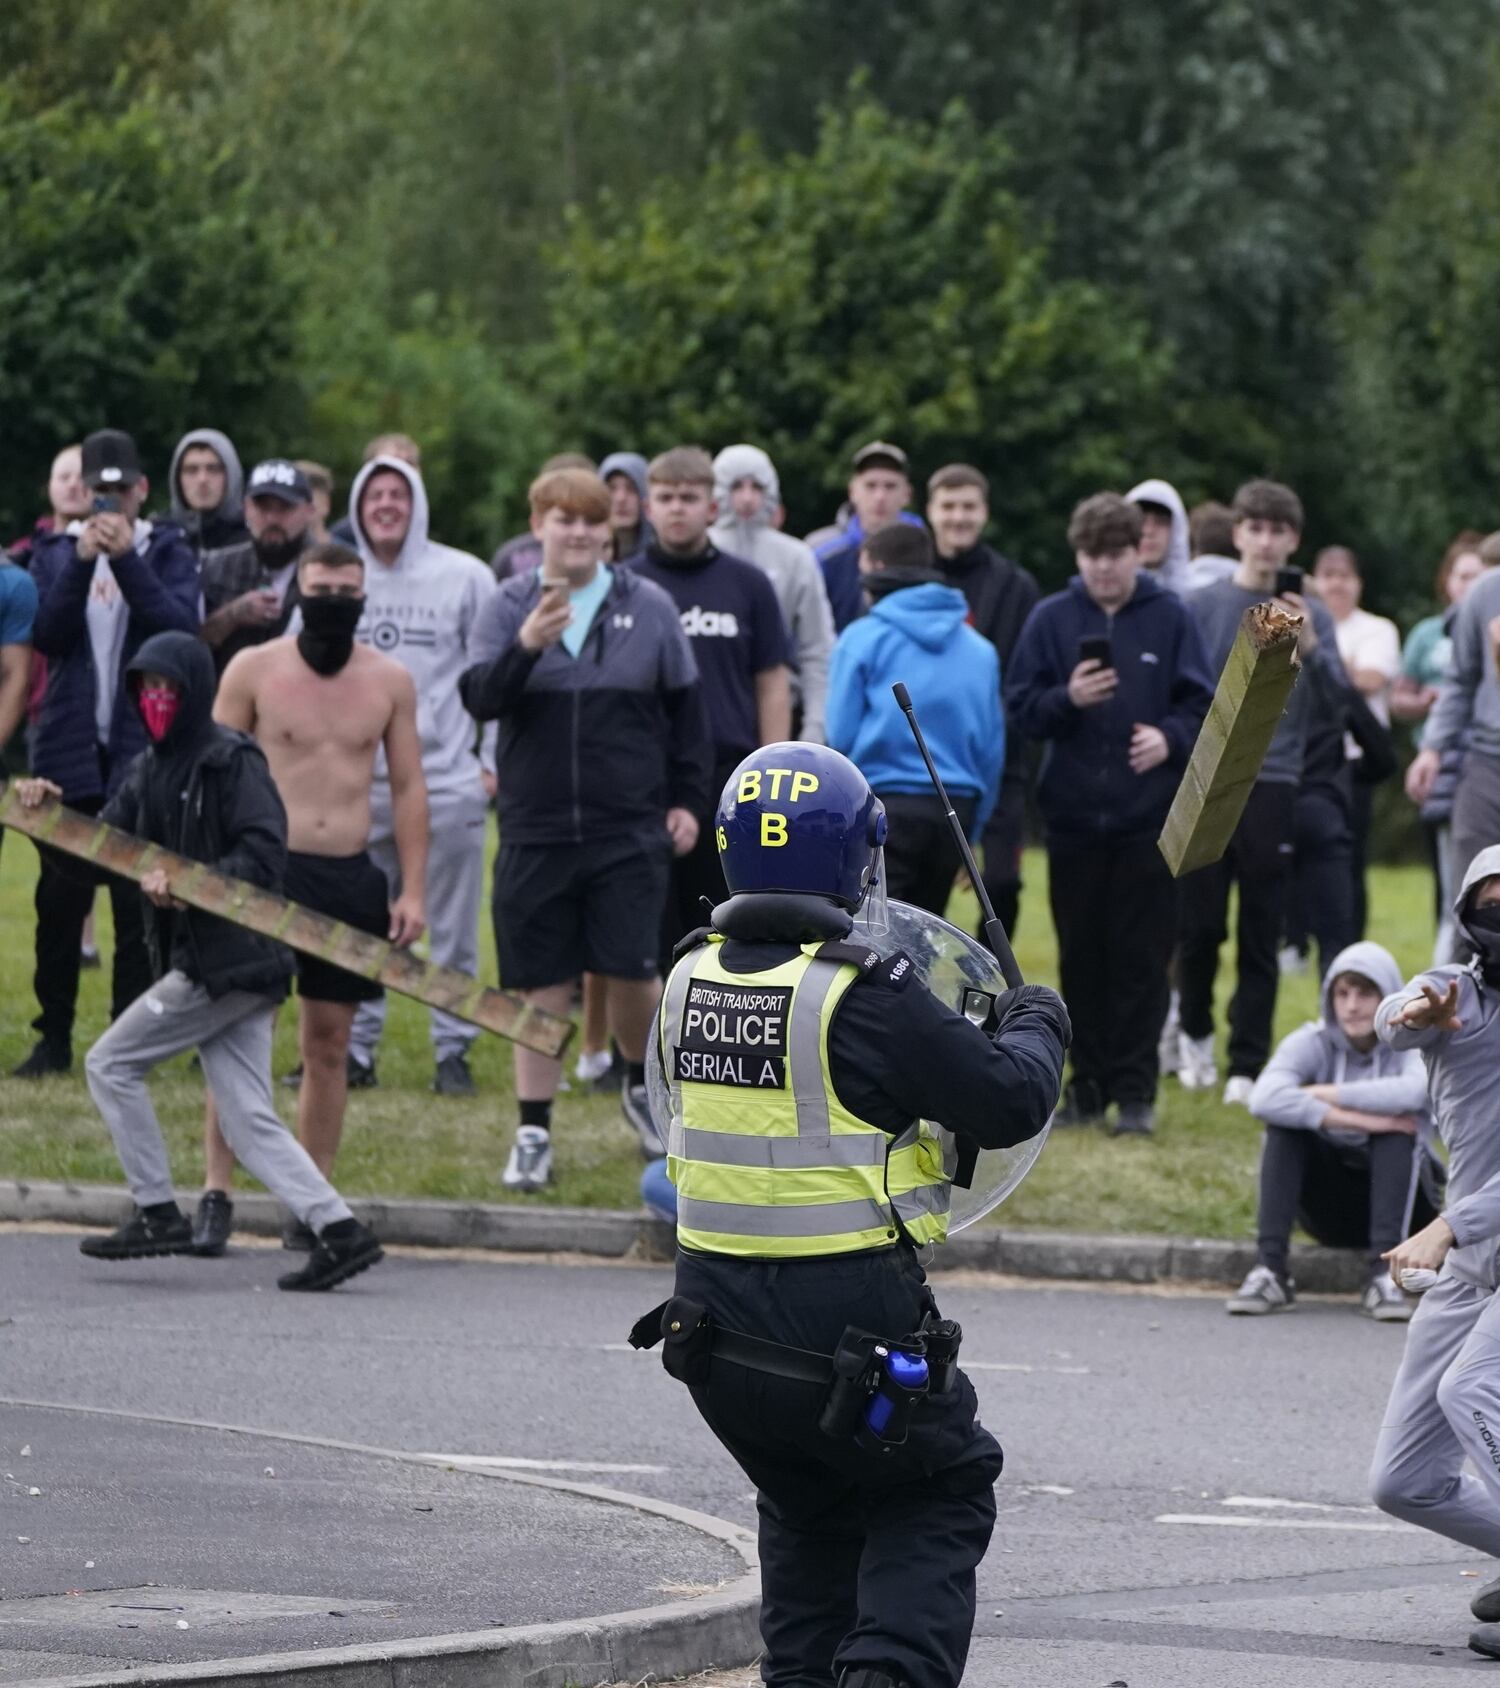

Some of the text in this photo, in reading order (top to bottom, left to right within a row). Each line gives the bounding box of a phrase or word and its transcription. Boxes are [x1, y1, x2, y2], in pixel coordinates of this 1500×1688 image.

[680, 604, 739, 637] das
[737, 768, 820, 804] BTP
[760, 812, 789, 847] B
[889, 958, 910, 981] 1686
[689, 987, 786, 1012] BRITISH TRANSPORT
[685, 1009, 782, 1046] POLICE
[679, 1051, 779, 1087] SERIAL A
